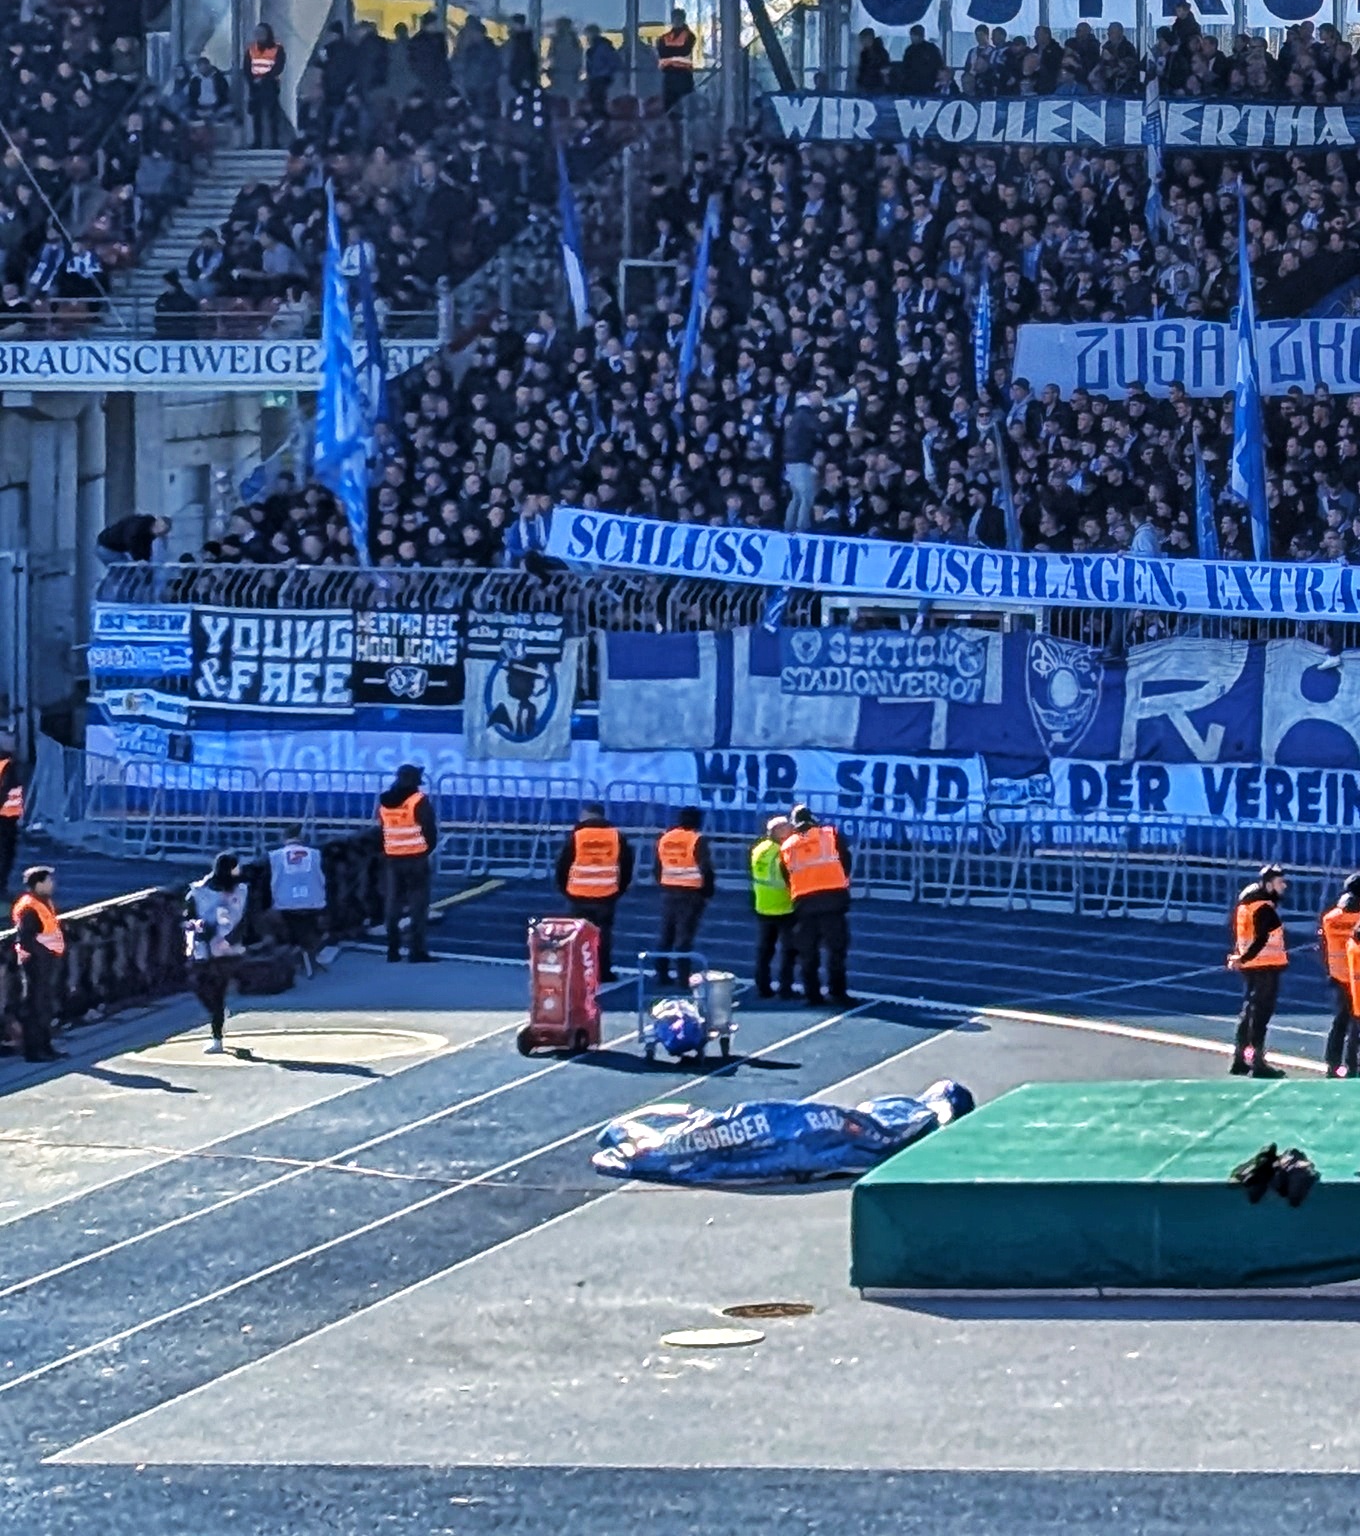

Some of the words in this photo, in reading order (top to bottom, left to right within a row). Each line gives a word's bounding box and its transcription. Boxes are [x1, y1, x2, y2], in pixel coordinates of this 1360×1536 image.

[772, 95, 878, 142] WIR
[894, 99, 1108, 145] WOLLEN
[1123, 101, 1357, 146] HERTHA
[567, 511, 767, 579] SCHLUSS
[786, 535, 869, 587] MIT
[887, 544, 1188, 612] ZUSCHLÄGEN,
[828, 631, 959, 667] SEKTION
[834, 758, 971, 815] SIND
[1067, 761, 1171, 814] DER
